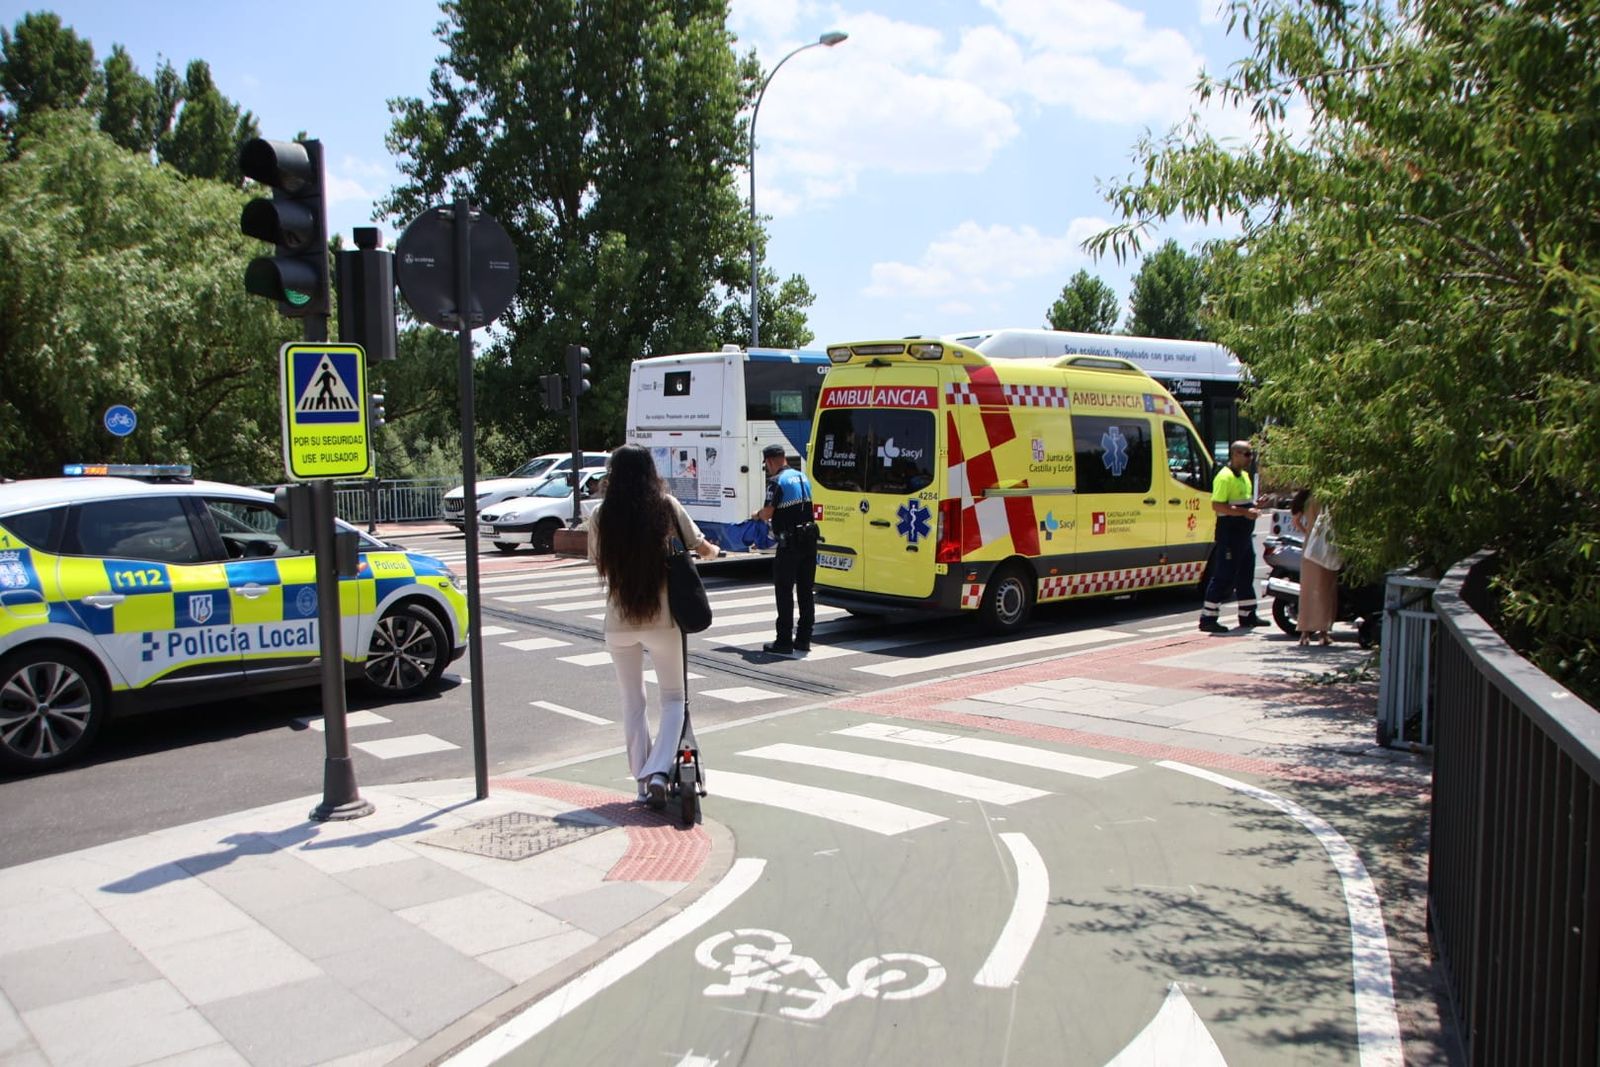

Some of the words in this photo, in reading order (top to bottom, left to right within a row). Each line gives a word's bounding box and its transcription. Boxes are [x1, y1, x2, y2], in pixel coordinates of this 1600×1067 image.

[1064, 344, 1077, 354] Soy
[1114, 347, 1149, 360] Propulsado
[1150, 352, 1162, 360] con
[1163, 353, 1174, 362] gas
[1175, 353, 1197, 362] natural
[826, 389, 928, 406] AMBULANCIA
[1072, 392, 1143, 408] AMBULANCIA
[294, 436, 309, 447] POR
[310, 436, 321, 446] SU
[322, 434, 363, 446] SEGURIDAD
[302, 453, 317, 464] USE
[319, 452, 359, 463] PULSADOR
[848, 451, 856, 459] de
[901, 448, 923, 459] Sacyl
[1046, 454, 1064, 462] Junta
[1065, 453, 1073, 462] de
[1029, 463, 1052, 473] Castilla
[1058, 464, 1073, 472] León
[919, 491, 938, 500] 4284
[1188, 498, 1200, 511] 112
[1060, 519, 1075, 530] Sacyl
[122, 569, 164, 587] 112
[168, 626, 250, 657] Policía
[259, 622, 314, 649] Local
